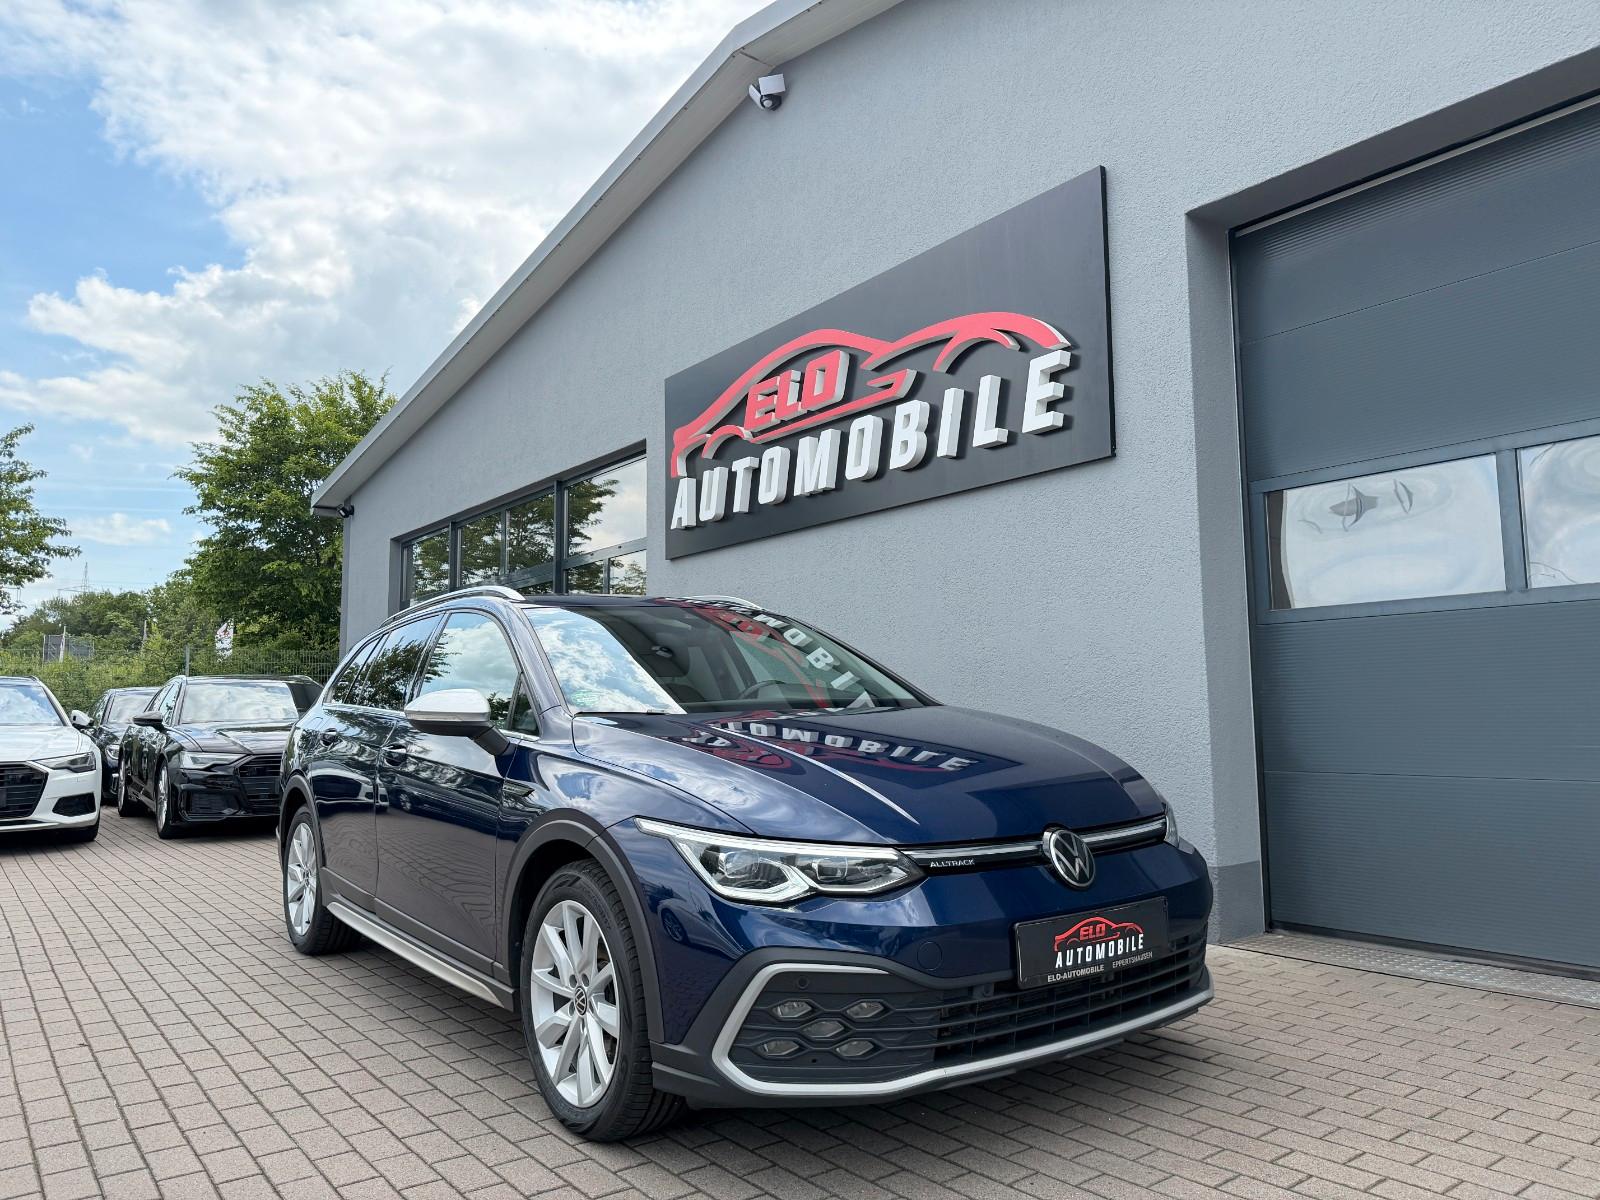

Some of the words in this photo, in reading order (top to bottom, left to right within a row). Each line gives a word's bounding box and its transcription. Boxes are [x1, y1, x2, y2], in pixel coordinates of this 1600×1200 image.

[743, 349, 850, 432] ELO
[670, 349, 1072, 530] AUTOMOBILE
[929, 858, 975, 868] ALLTRACK
[1080, 923, 1106, 940] ELO
[1047, 964, 1105, 983] ELO-AUTOMOBILE
[1112, 951, 1153, 969] EPPERTSHAUSEN
[1055, 933, 1144, 969] AUTOMOBILE
